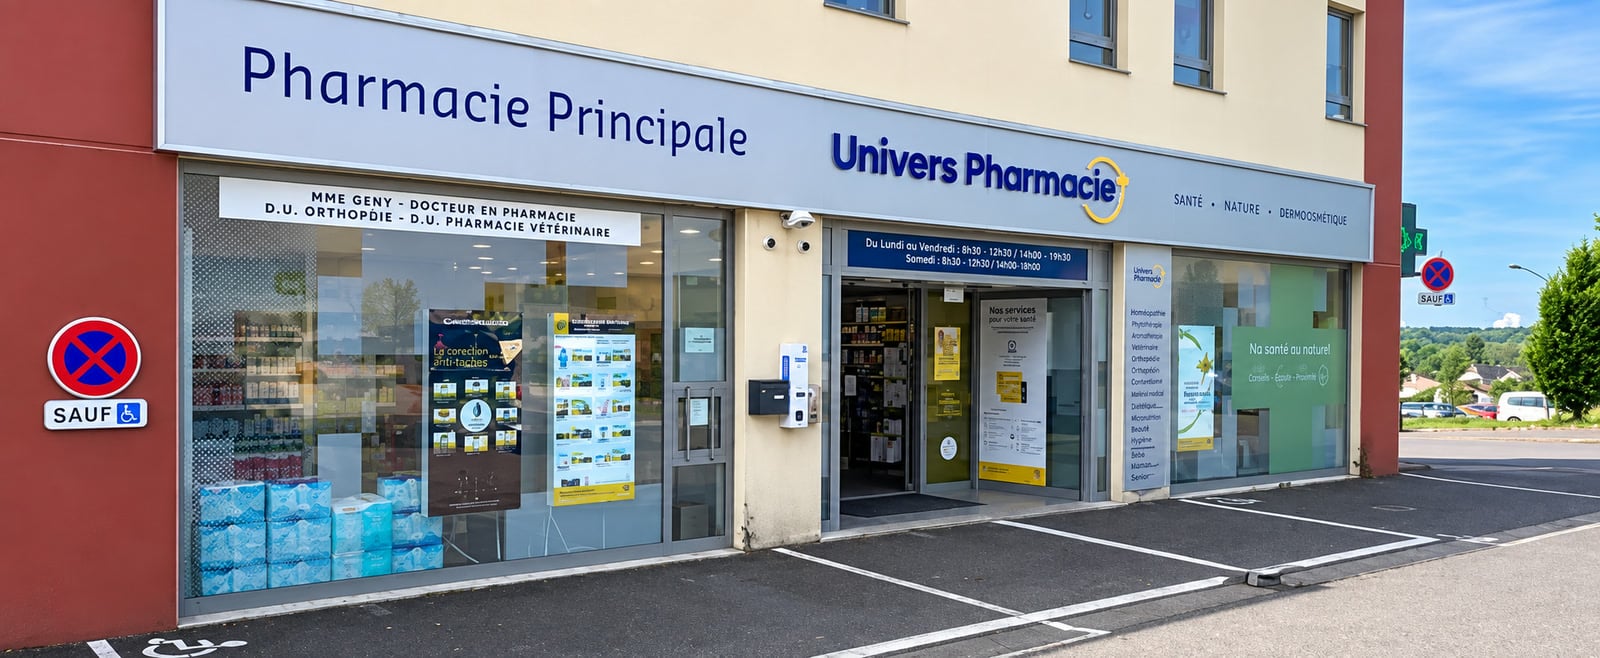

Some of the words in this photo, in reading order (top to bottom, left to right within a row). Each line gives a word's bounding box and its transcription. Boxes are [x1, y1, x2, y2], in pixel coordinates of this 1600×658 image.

[243, 46, 530, 128] Pharmacie
[548, 91, 748, 157] Principale
[832, 132, 958, 184] Univers
[965, 152, 1117, 203] Pharmacie
[311, 192, 346, 205] MME
[352, 195, 393, 208] GENY
[410, 199, 475, 215] DOCTEUR
[481, 206, 498, 216] EN
[503, 208, 576, 223] PHARMACIE
[1174, 193, 1203, 208] SANTÉ
[1224, 200, 1260, 215] NATURE
[265, 203, 298, 216] D.U.
[410, 214, 440, 226] D.U.
[446, 217, 525, 232] PHARMACIE
[530, 221, 611, 238] VÉTÉRINAIRE
[865, 237, 878, 248] Du
[880, 239, 904, 250] Lundi
[906, 242, 917, 250] au
[919, 242, 955, 254] Vendredi
[961, 245, 981, 256] 8h30
[989, 248, 1012, 258] 12h30
[1020, 250, 1042, 260] 14h00
[1049, 252, 1072, 262] 19h30
[905, 253, 936, 265] Samedi
[941, 257, 961, 267] 8h30
[968, 258, 990, 269] 12h30
[1421, 295, 1443, 303] SAUF
[989, 306, 1004, 315] Nos
[1005, 305, 1036, 314] services
[433, 347, 445, 356] La
[1264, 342, 1289, 355] santé
[1290, 345, 1301, 355] au
[53, 406, 112, 423] SAUF
